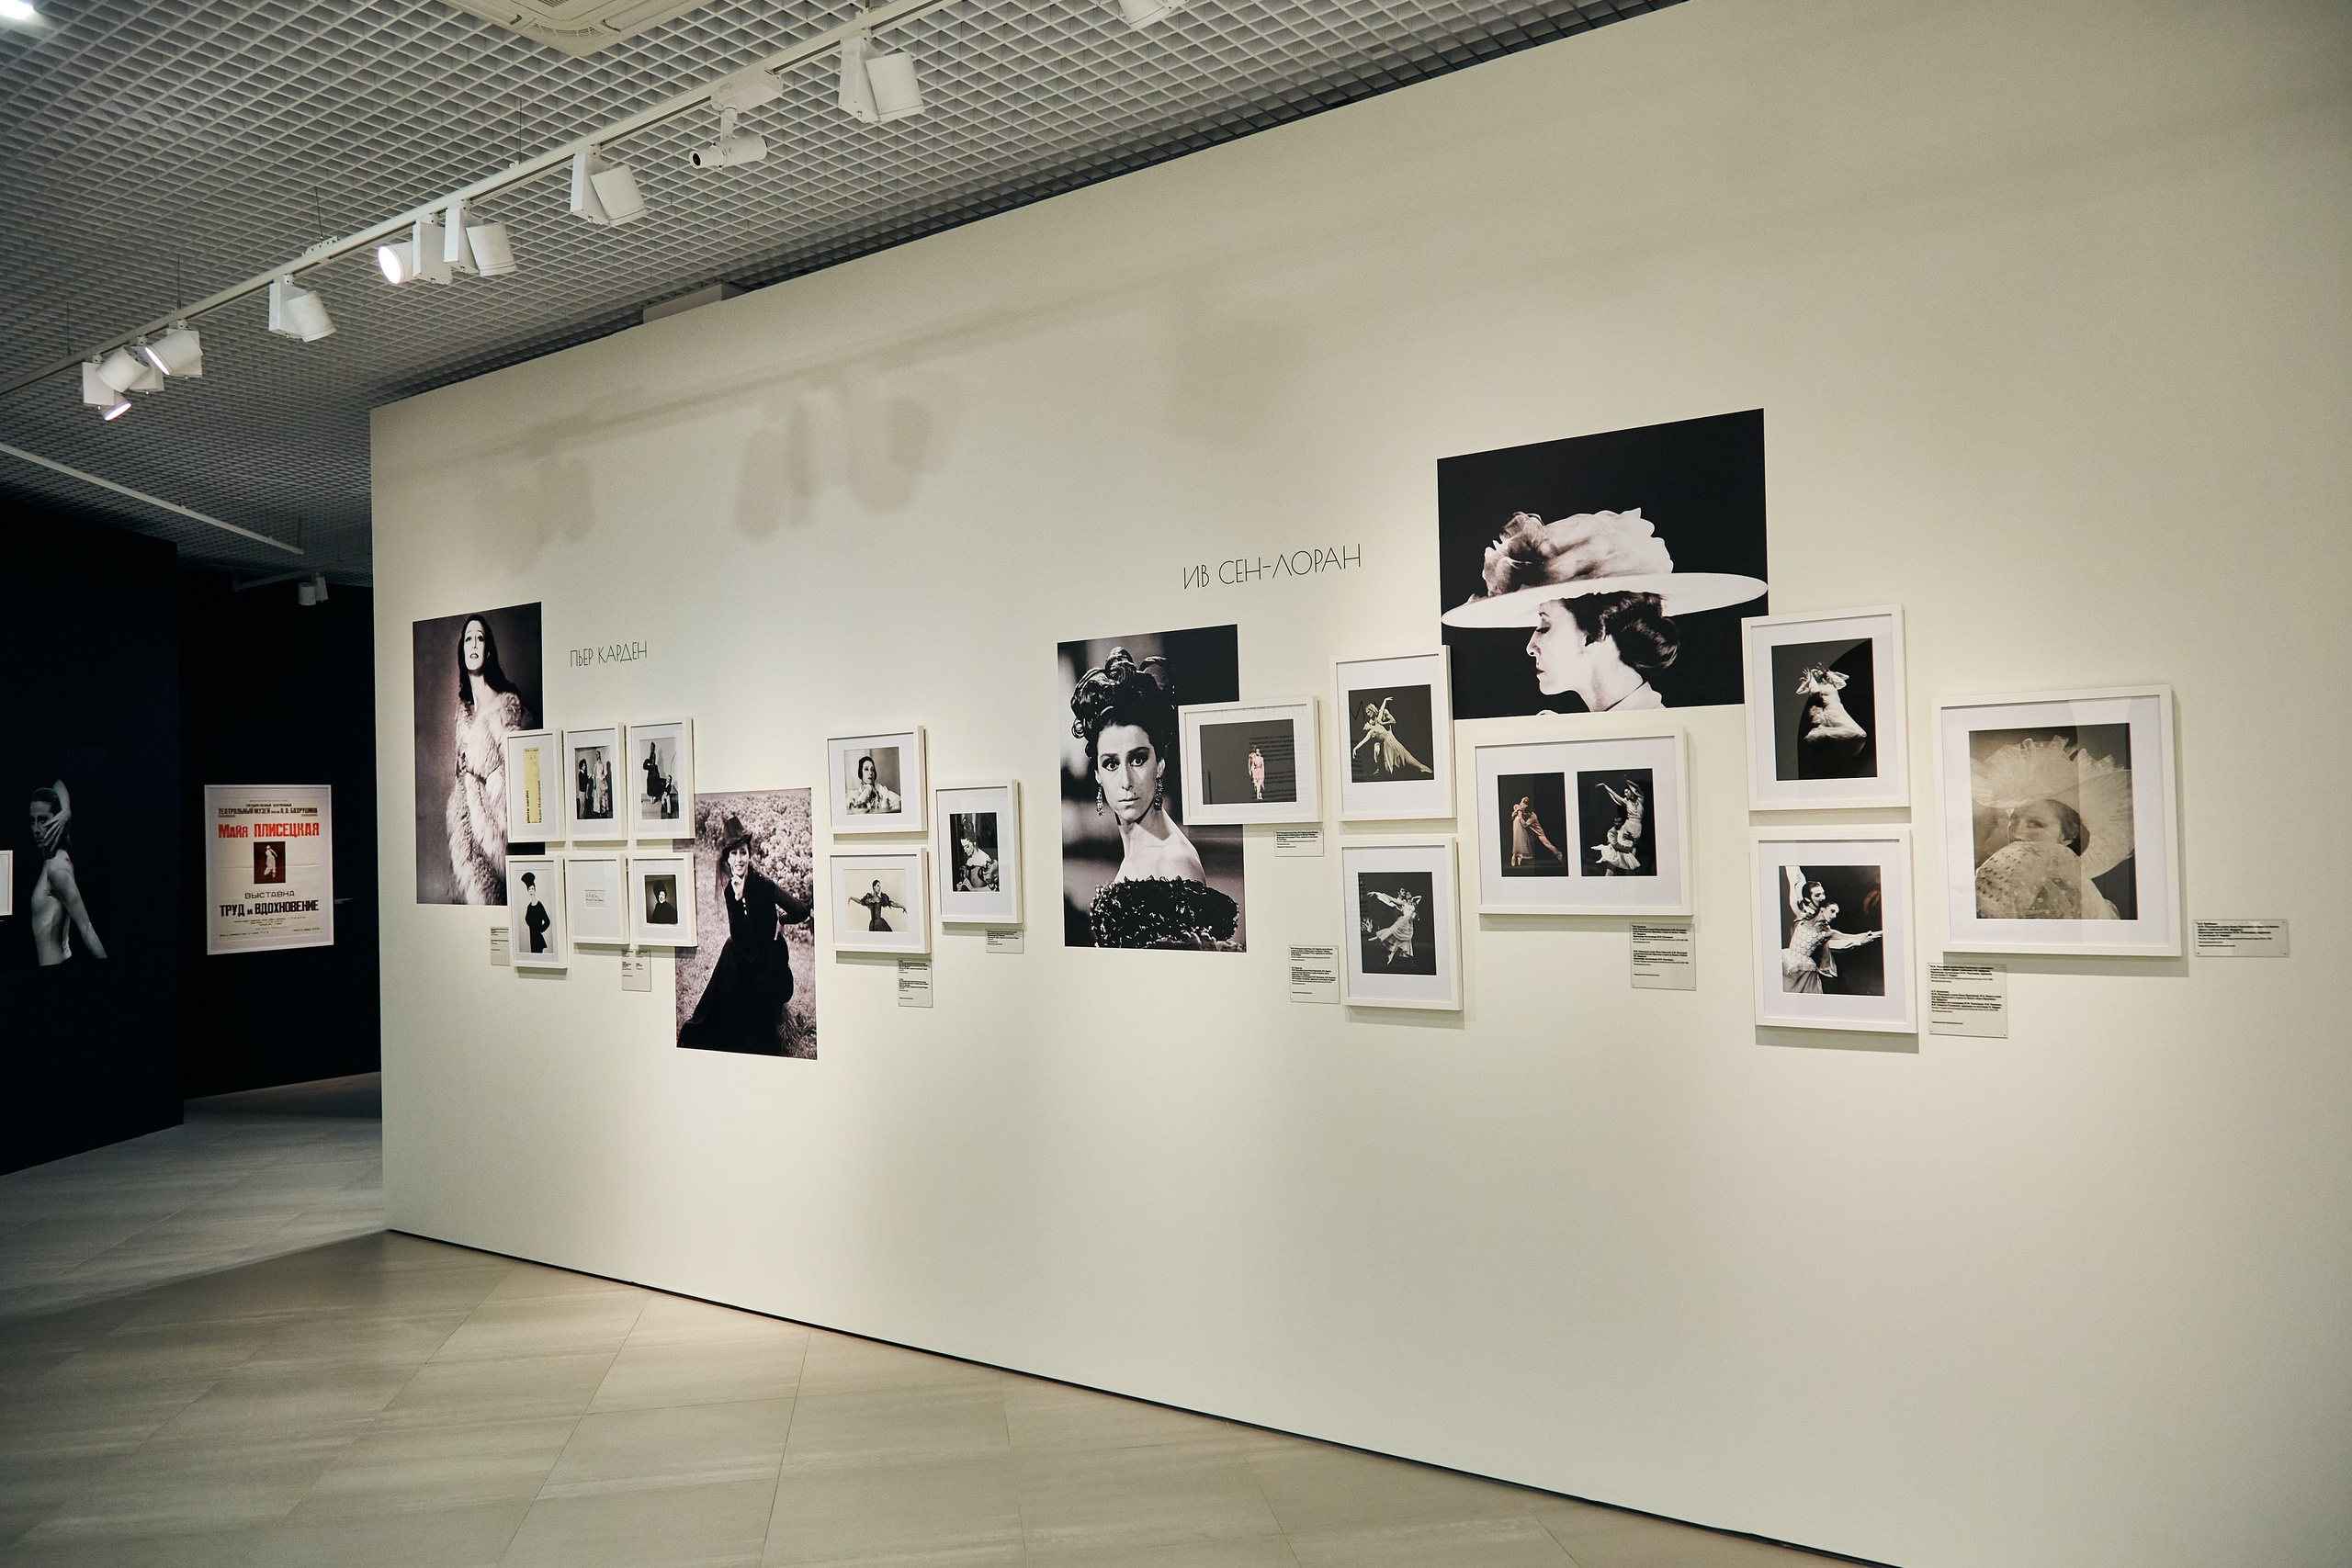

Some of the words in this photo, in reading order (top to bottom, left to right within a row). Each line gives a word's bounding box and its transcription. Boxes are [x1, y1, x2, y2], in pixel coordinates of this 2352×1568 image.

[1183, 564, 1210, 590] ИВ
[1218, 543, 1361, 585] СЕН-ЛОРАН
[570, 648, 594, 667] ПЬЕР
[597, 640, 648, 664] КАРДЕН
[254, 822, 320, 838] ПЛИСЕЦКАЯ
[244, 890, 295, 899] ВЫСТАВКА
[220, 904, 245, 917] ТРУД
[254, 899, 319, 916] ВДОХНОВЕНИЕ
